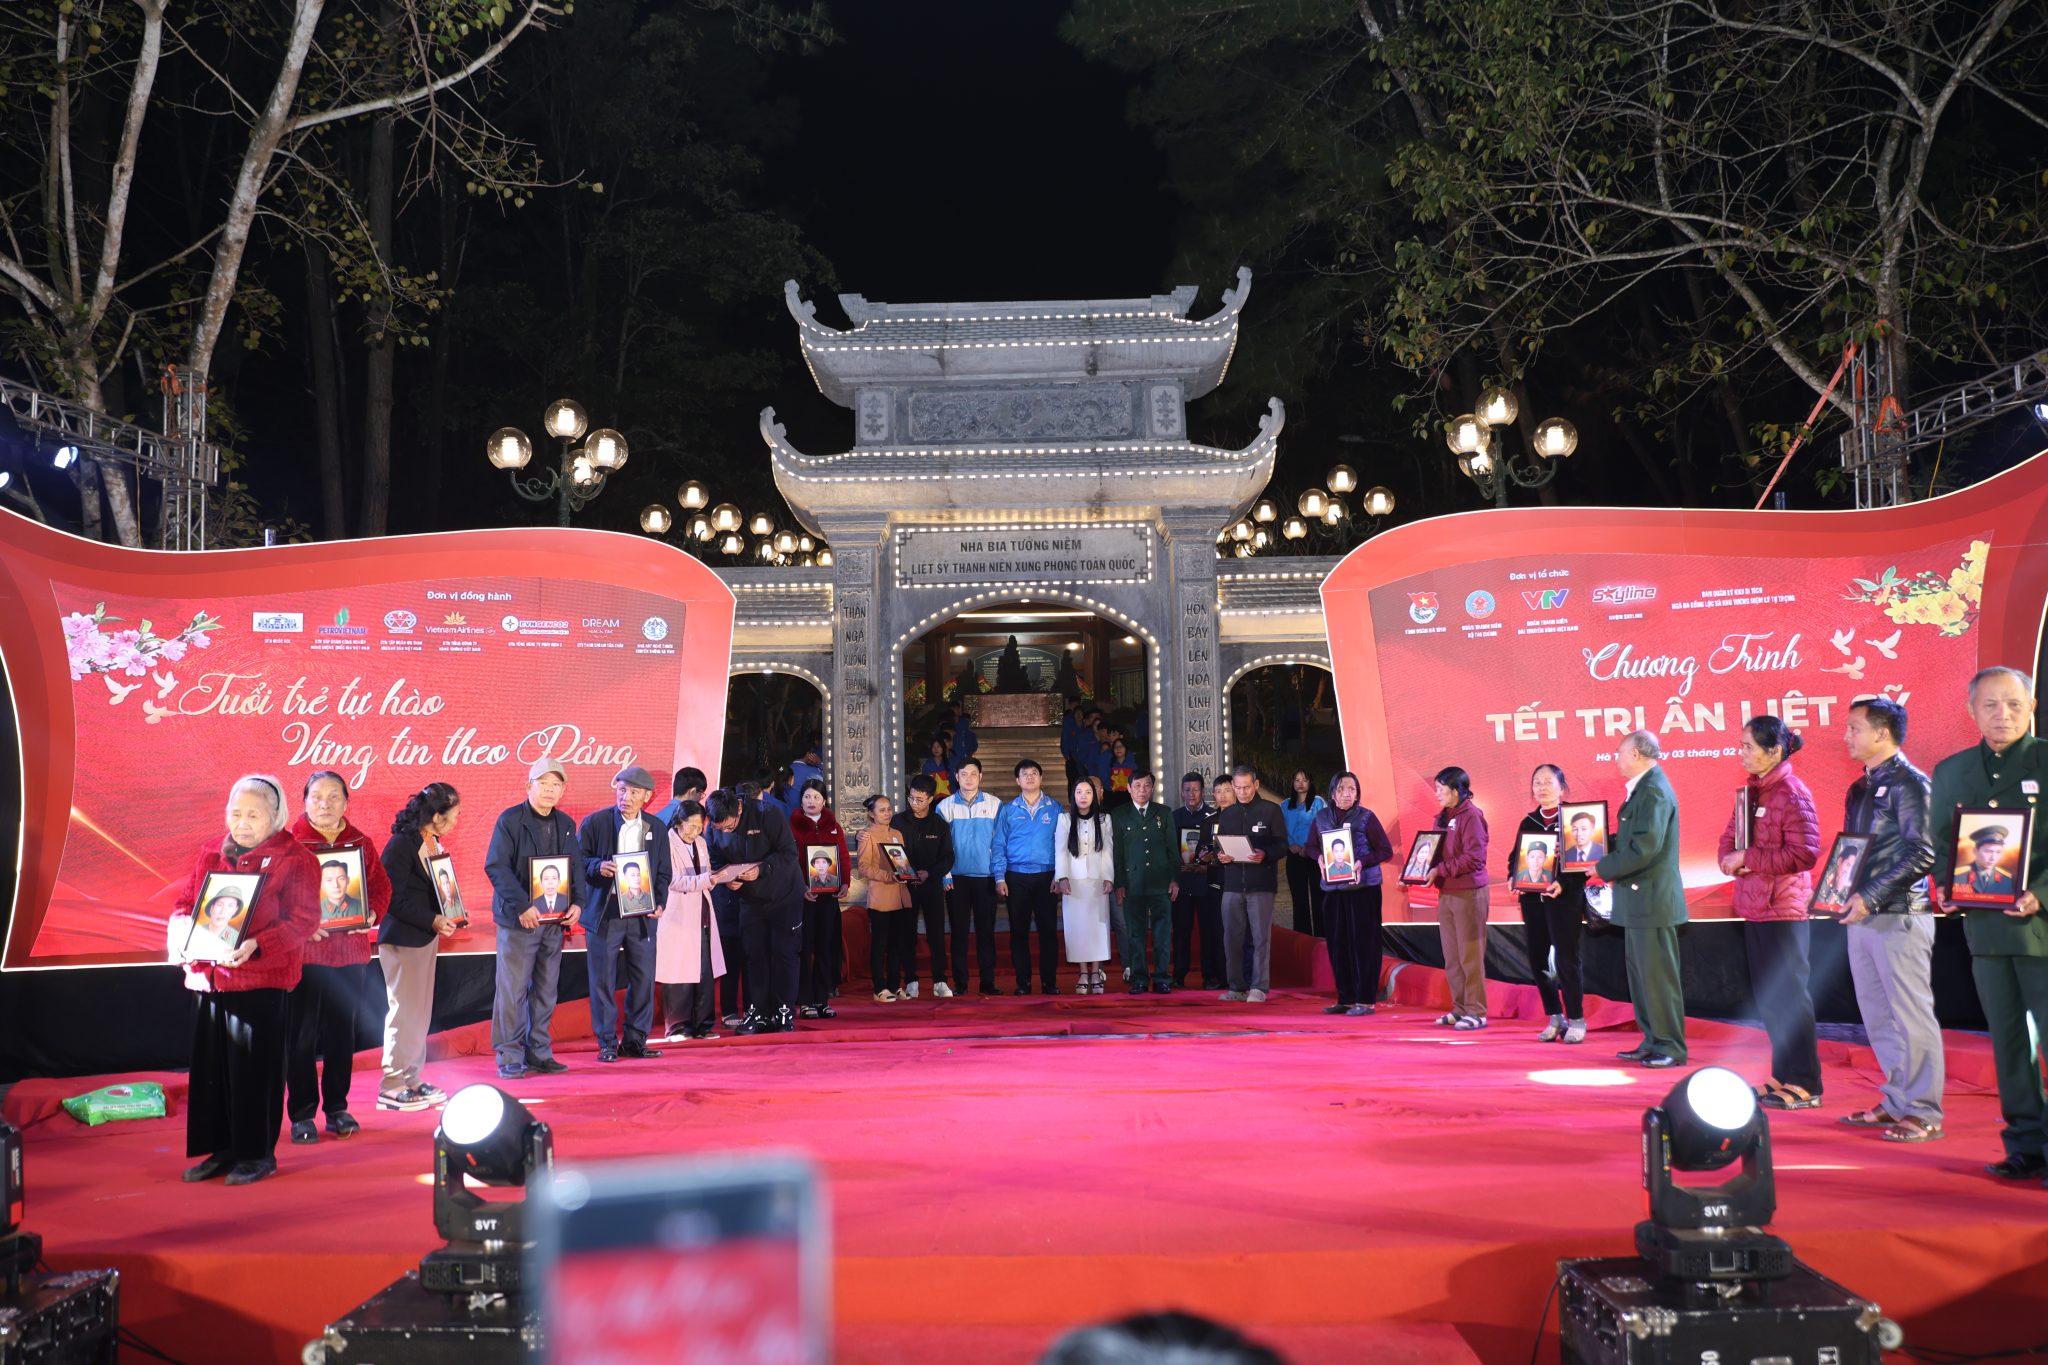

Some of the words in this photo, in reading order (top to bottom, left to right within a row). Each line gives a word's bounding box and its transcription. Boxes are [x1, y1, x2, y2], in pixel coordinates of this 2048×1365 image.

[987, 541, 1007, 552] BIA
[1052, 536, 1082, 554] NIỆM
[952, 562, 985, 574] THANH
[989, 559, 1012, 573] NIÊN
[1015, 561, 1041, 572] XUNG
[1044, 560, 1077, 571] PHONG
[1108, 554, 1135, 571] QUỐC
[1509, 572, 1526, 581] Đơn
[1528, 571, 1536, 580] vị
[1549, 569, 1569, 578] chức
[427, 591, 446, 600] Đơn
[449, 592, 458, 601] vị
[460, 591, 485, 602] đồng
[488, 592, 512, 600] hành
[1521, 589, 1569, 610] VTV
[582, 618, 620, 628] DREAM
[1187, 626, 1208, 639] BAY
[1582, 643, 1700, 696] Chương
[1708, 632, 1803, 674] Trình
[178, 673, 273, 715] Tuổi
[282, 676, 328, 715] trẻ
[338, 677, 372, 720] tự
[379, 678, 445, 716] hào
[1188, 696, 1210, 708] LINH
[1189, 715, 1210, 733] KHÍ
[1485, 701, 1566, 742] TẾT
[1575, 706, 1646, 738] TRI
[1659, 696, 1726, 734] ÂN
[282, 722, 378, 790] Vững
[387, 726, 433, 765] tin
[441, 726, 510, 766] theo
[1596, 753, 1611, 761] Hà
[1672, 750, 1685, 758] 03
[1687, 748, 1720, 759] tháng
[1722, 748, 1736, 756] 02
[1704, 1205, 1727, 1217] SVT
[475, 1219, 497, 1231] SVT
